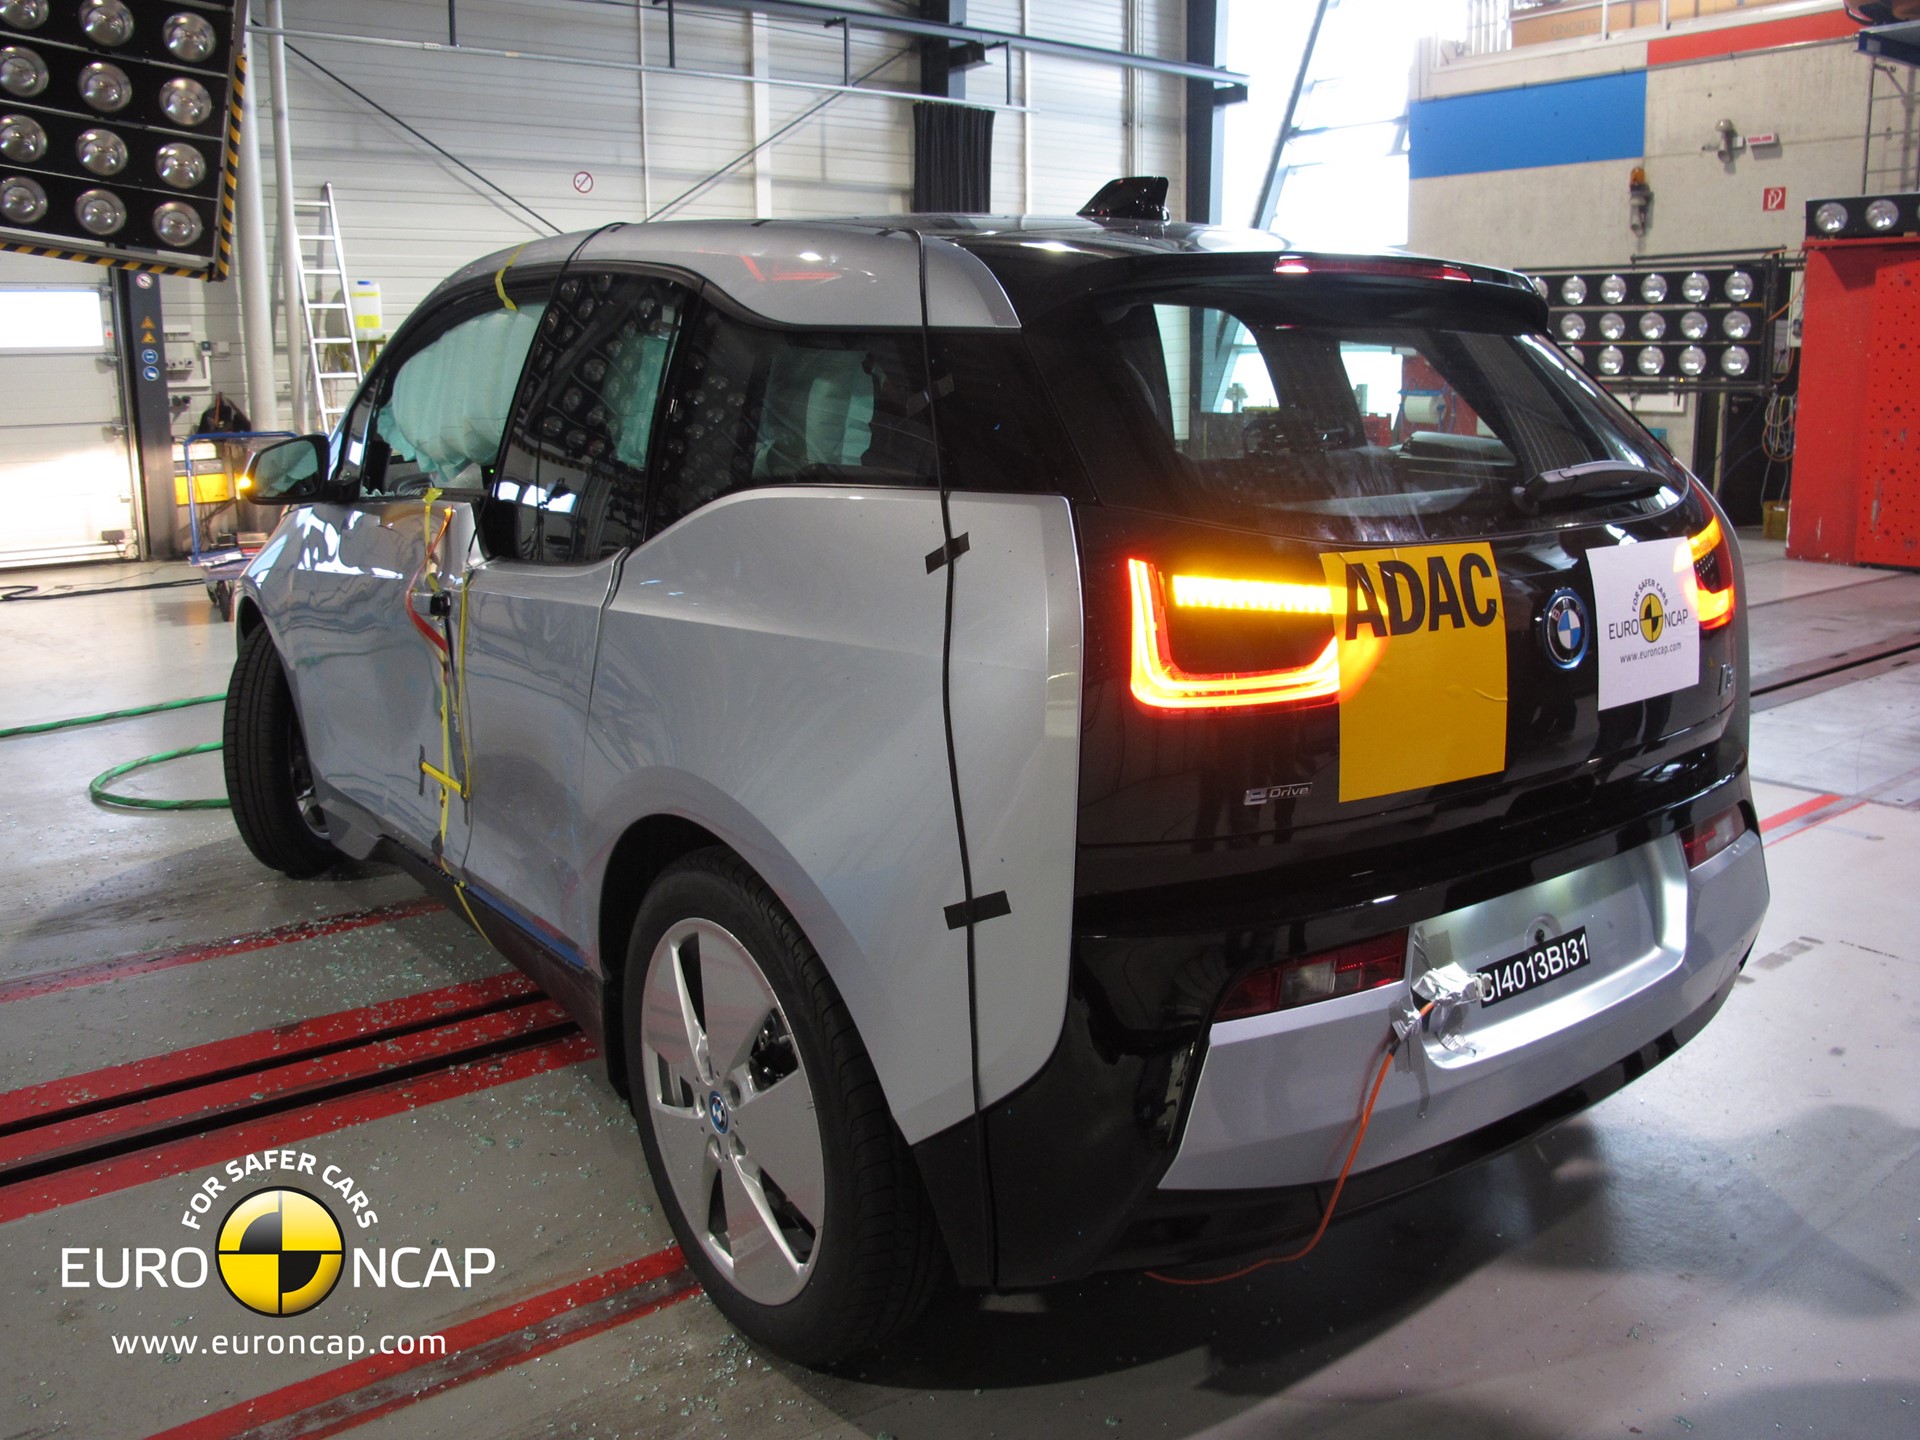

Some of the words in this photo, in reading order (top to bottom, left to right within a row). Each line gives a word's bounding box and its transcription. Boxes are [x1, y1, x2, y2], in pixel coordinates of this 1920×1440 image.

[1345, 553, 1497, 641] ADAC
[1632, 591, 1640, 612] FOR
[1638, 578, 1656, 593] SAFER
[1656, 583, 1668, 606] CARS
[1608, 619, 1640, 640] EURO
[1664, 608, 1689, 628] NCAP
[1619, 642, 1682, 663] www.euroncap.com
